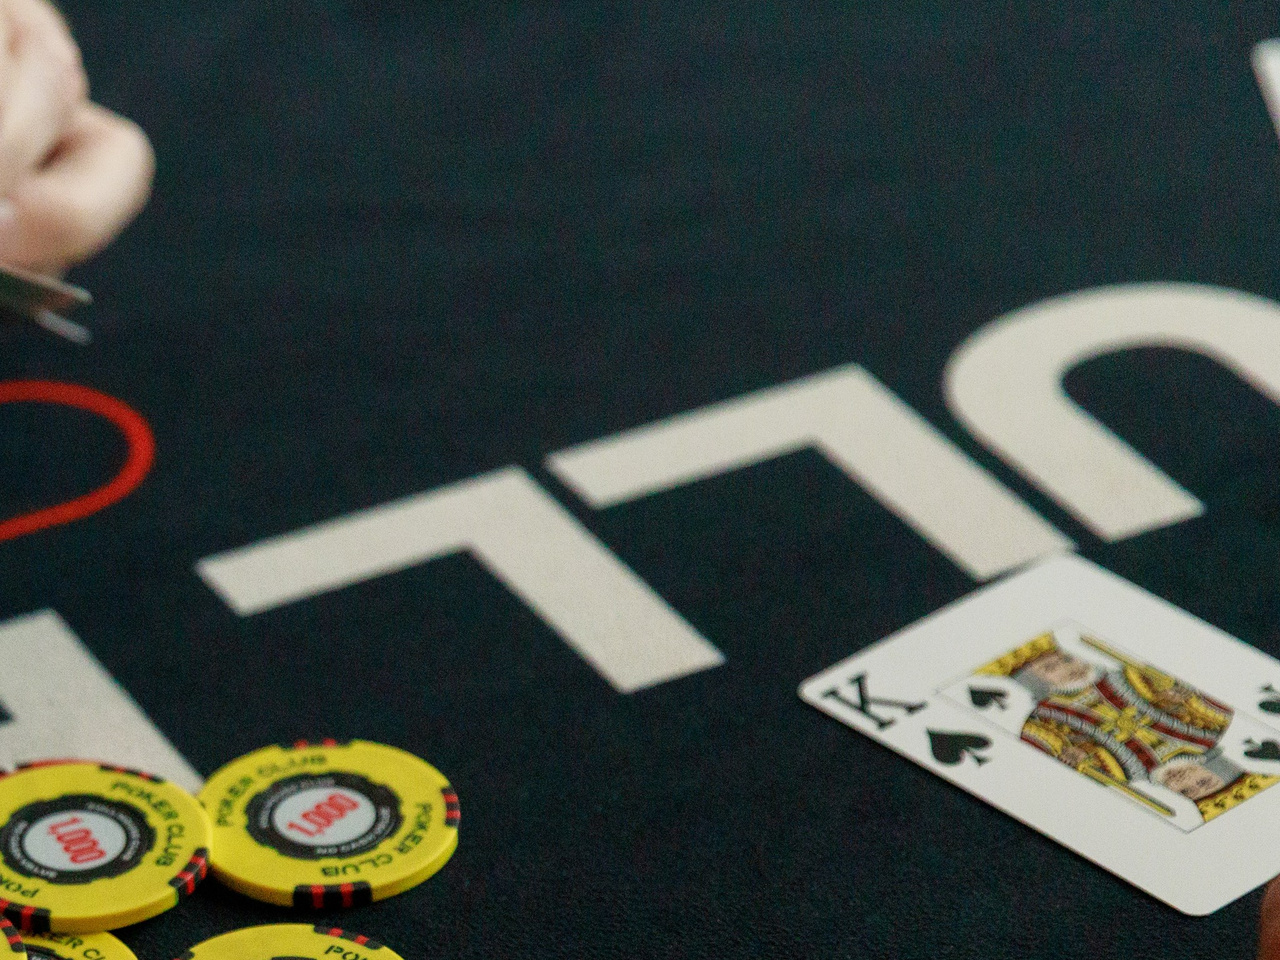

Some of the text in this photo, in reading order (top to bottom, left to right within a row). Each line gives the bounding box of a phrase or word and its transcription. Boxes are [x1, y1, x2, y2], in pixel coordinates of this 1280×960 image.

[821, 671, 928, 733] K
[287, 792, 360, 837] 1,000
[47, 816, 106, 863] 1,000
